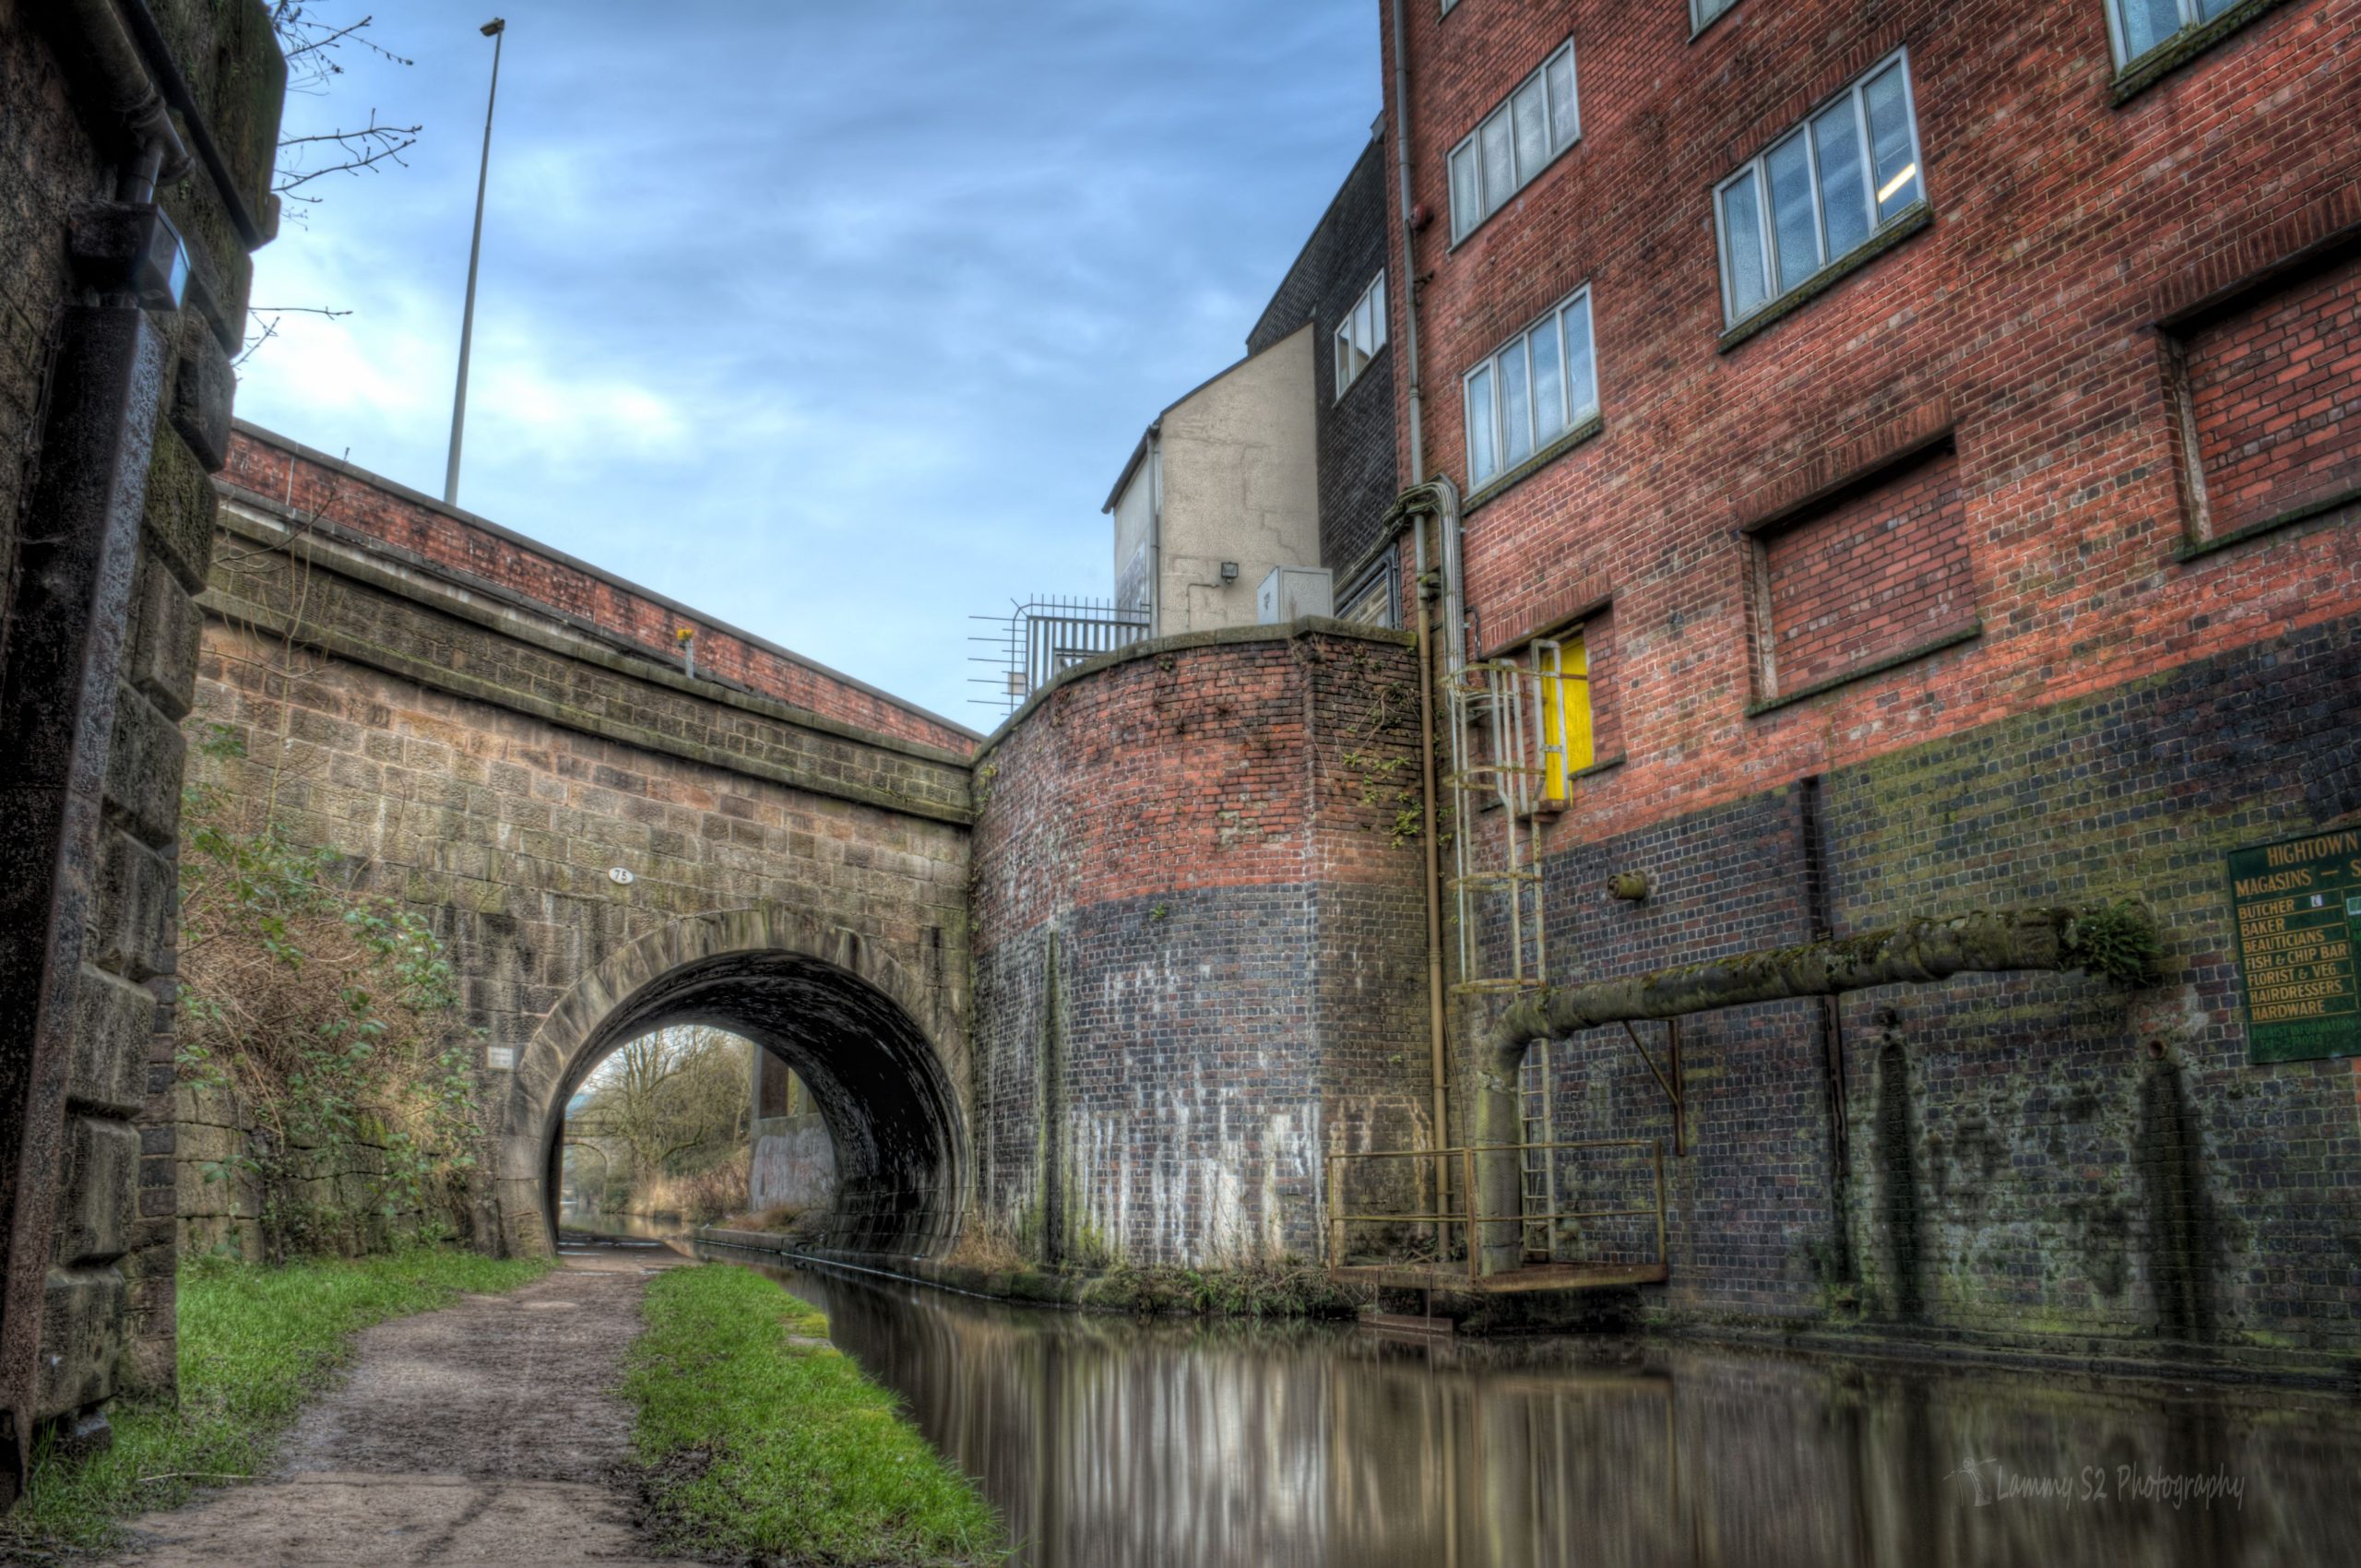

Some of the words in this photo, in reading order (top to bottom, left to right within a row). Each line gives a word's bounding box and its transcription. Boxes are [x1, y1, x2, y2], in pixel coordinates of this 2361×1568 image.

[2267, 832, 2358, 866] HIGHTOWN
[614, 869, 627, 881] 75
[2234, 868, 2312, 897] MAGASINS
[2237, 899, 2295, 920] BUTCHER
[2240, 918, 2285, 937] BAKER
[2243, 929, 2325, 954] BEAUTICIANS
[2245, 955, 2272, 970] FISH
[2275, 955, 2285, 966] &
[2287, 948, 2318, 965] CHIP
[2319, 943, 2347, 960] BAR
[2247, 968, 2295, 987] FLORIST
[2298, 968, 2308, 980] &
[2250, 980, 2343, 1004] HAIRDRESSERS
[2251, 1000, 2325, 1021] HARDWARE
